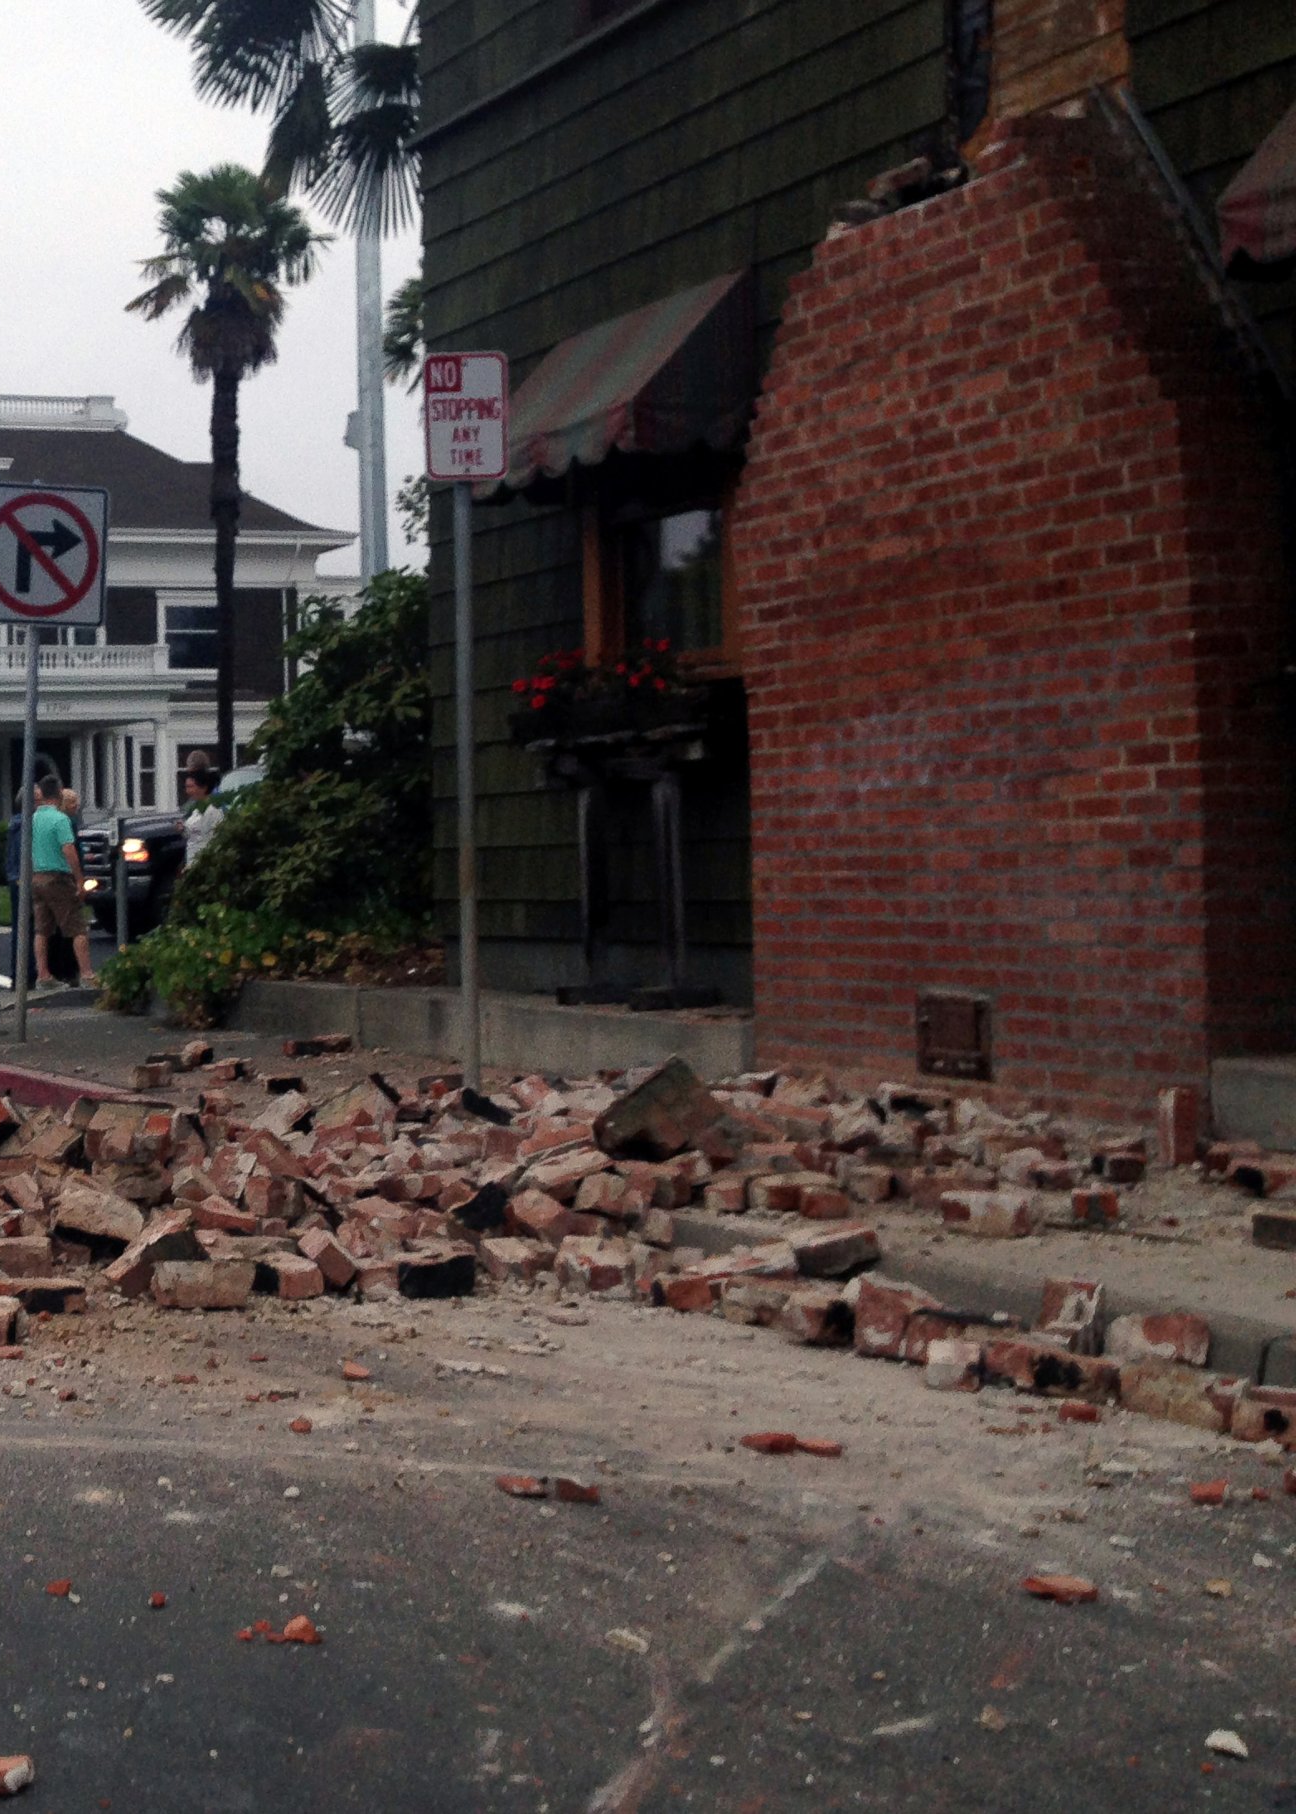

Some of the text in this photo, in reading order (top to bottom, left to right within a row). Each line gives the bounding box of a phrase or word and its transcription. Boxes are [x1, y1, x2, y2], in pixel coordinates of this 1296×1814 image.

[430, 361, 456, 387] NO
[431, 396, 503, 421] STOPPING
[452, 427, 481, 443] ANY
[450, 448, 482, 466] TIME
